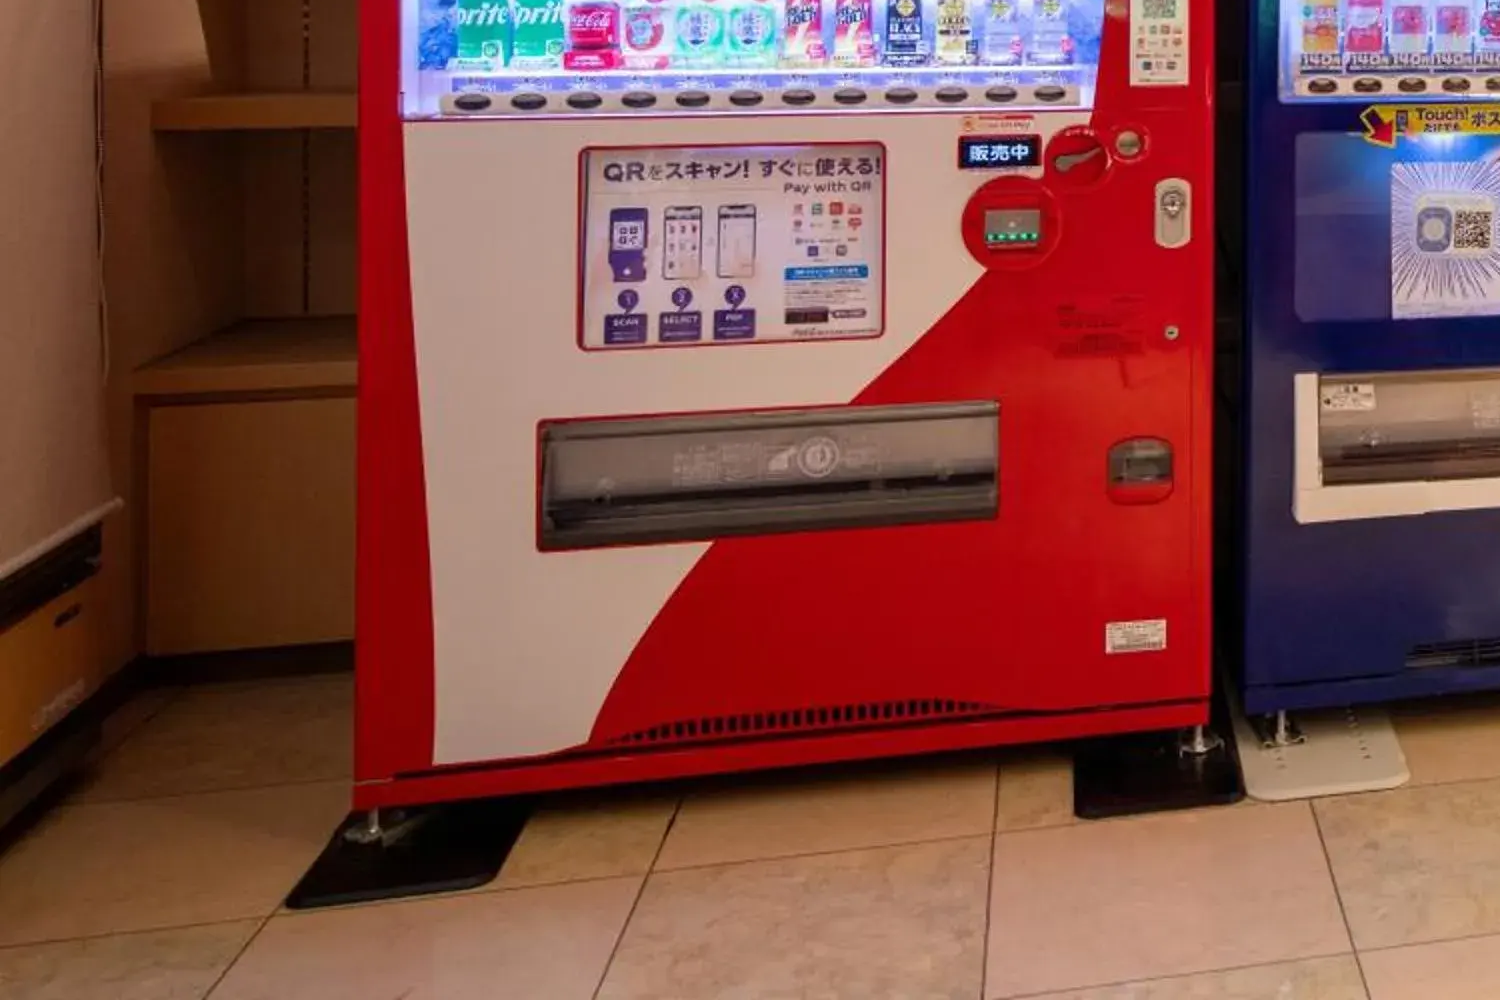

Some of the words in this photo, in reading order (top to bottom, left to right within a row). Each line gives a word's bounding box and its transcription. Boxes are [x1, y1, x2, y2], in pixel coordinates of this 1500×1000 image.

[1416, 107, 1469, 122] Touch!
[968, 144, 1030, 162] 販売中
[603, 159, 749, 182] QRをスキャン!
[758, 156, 882, 179] すぐに使える!
[784, 182, 809, 195] Pay
[813, 181, 846, 193] with
[851, 181, 872, 192] QR
